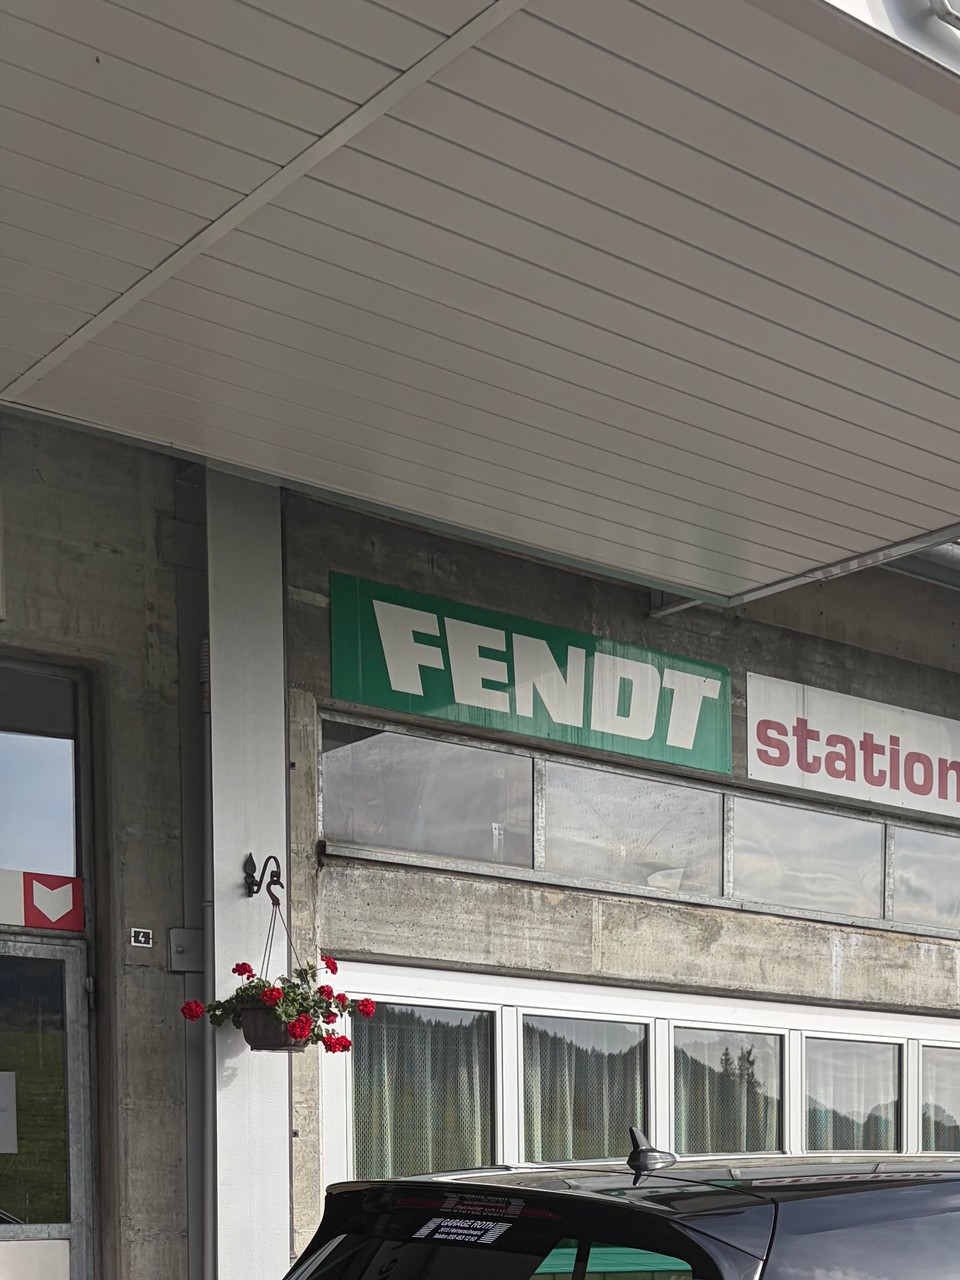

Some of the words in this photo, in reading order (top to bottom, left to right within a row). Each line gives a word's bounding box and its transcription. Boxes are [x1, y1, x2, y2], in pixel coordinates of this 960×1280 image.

[371, 598, 722, 751] FENDT
[441, 1219, 475, 1228] GARAGE
[471, 1220, 497, 1229] ROTH
